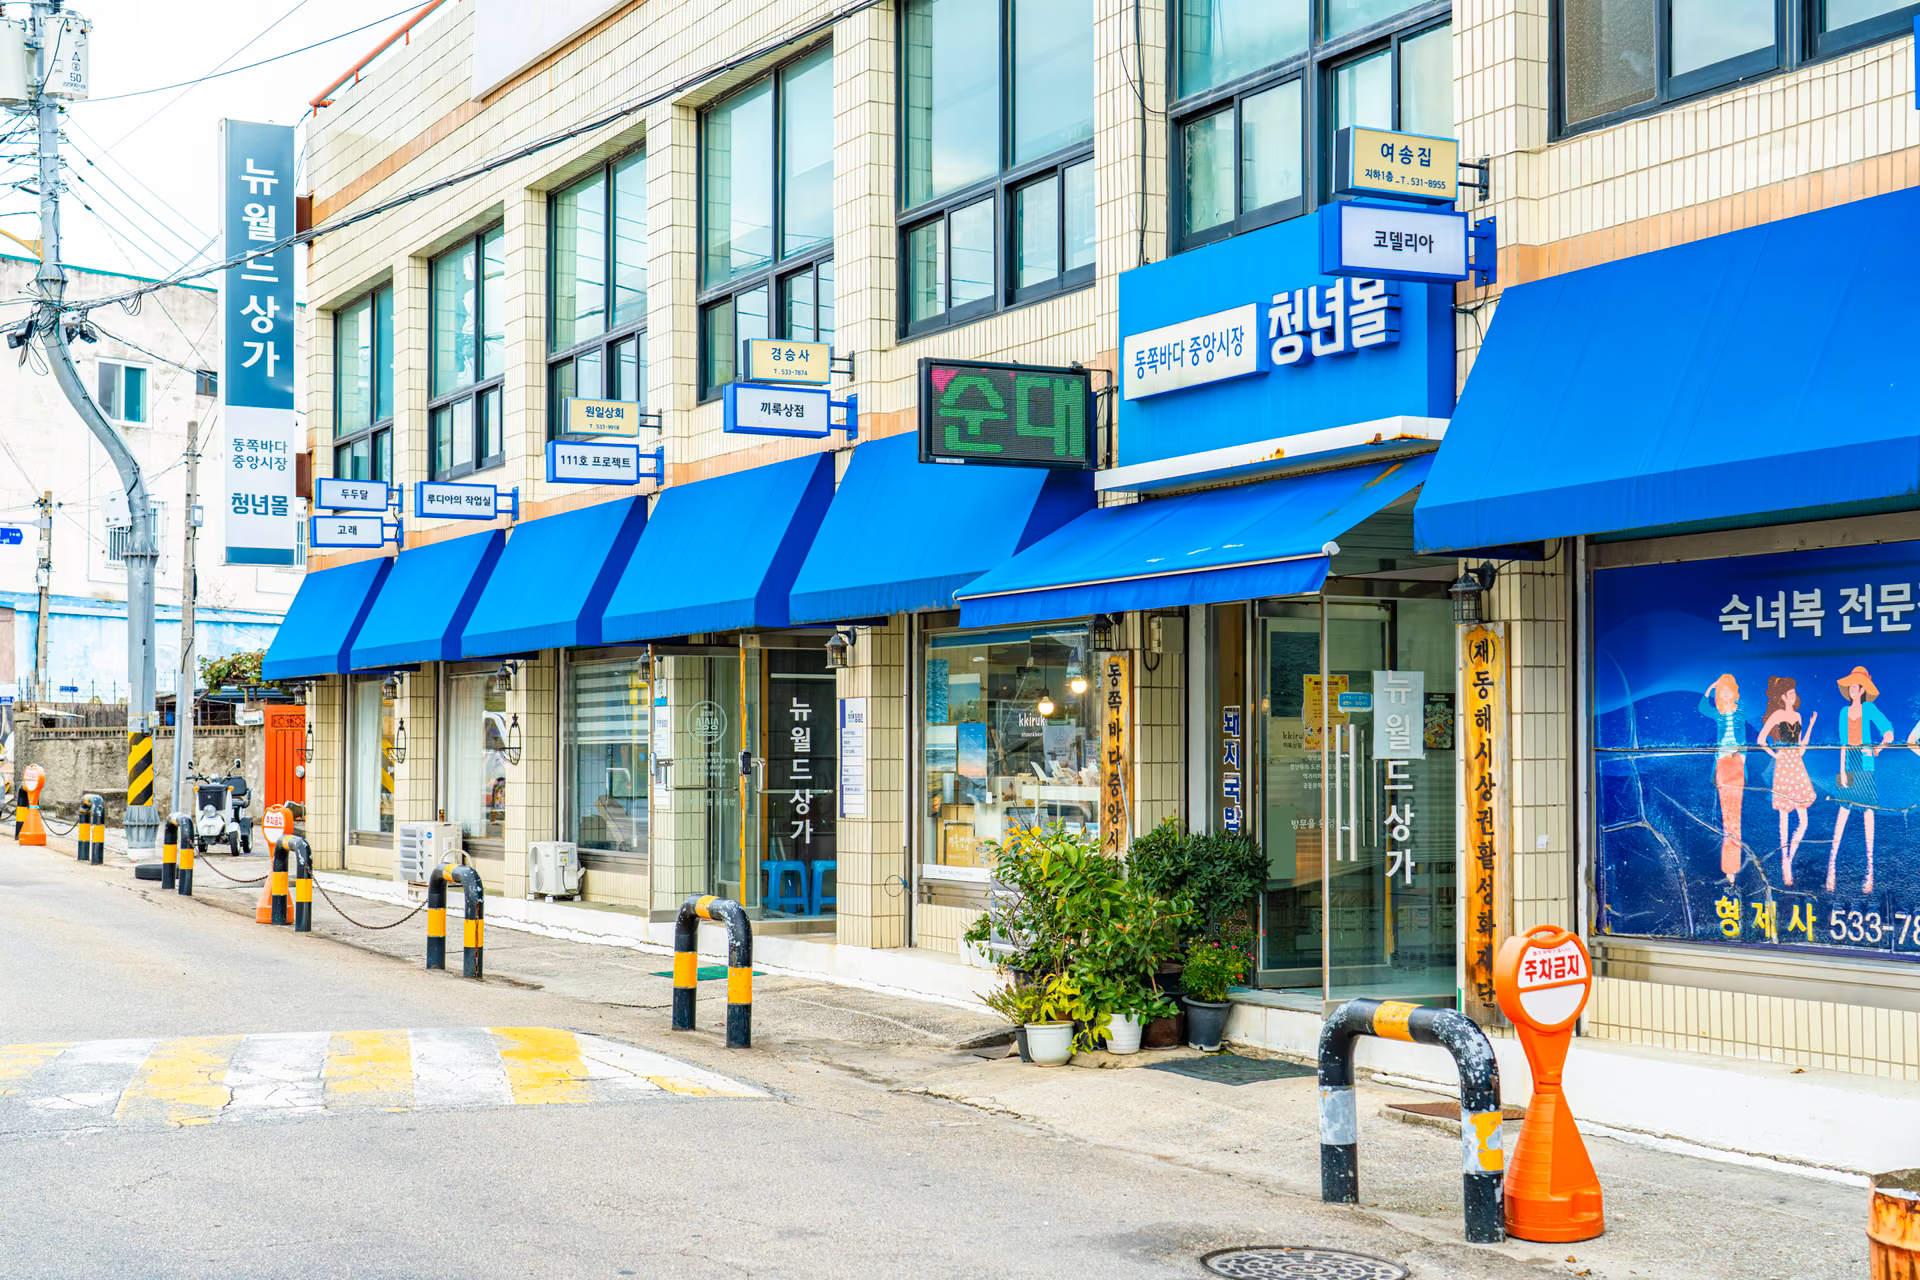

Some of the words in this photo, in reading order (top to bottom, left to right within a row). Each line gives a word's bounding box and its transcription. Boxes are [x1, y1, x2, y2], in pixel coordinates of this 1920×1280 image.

[1380, 143, 1432, 168] 여송집
[1364, 168, 1394, 183] 지하1층
[1410, 177, 1446, 190] 531-8955
[1373, 229, 1435, 255] 코델리아
[239, 158, 280, 377] 뉴월드상가
[1268, 277, 1388, 366] 청년몰
[771, 347, 810, 363] 경승사
[1134, 338, 1186, 380] 동쪽바다
[1188, 324, 1245, 368] 중앙시장
[585, 405, 625, 420] 원일상회
[760, 401, 804, 418] 끼룩상점
[937, 374, 1086, 458] 순대
[231, 437, 289, 455] 동쪽바다
[231, 454, 289, 472] 중앙시장
[560, 453, 589, 467] 111호
[591, 455, 632, 469] 프로젝트
[230, 491, 289, 517] 청년몰
[340, 488, 369, 502] 두두달
[426, 493, 463, 506] 루디아의
[464, 494, 492, 508] 작업실
[337, 525, 359, 537] 고래
[1718, 588, 1826, 641] 숙녀복
[1838, 582, 1920, 635] 전문
[1018, 712, 1046, 728] kkiruk
[789, 696, 814, 844] 뉴월드상가
[1107, 663, 1124, 868] 동쪽바다중앙시
[1384, 670, 1416, 885] 뉴월드상가
[1291, 818, 1317, 830] 방문을
[1714, 895, 1817, 941] 형제사
[1524, 954, 1580, 983] 주차금지
